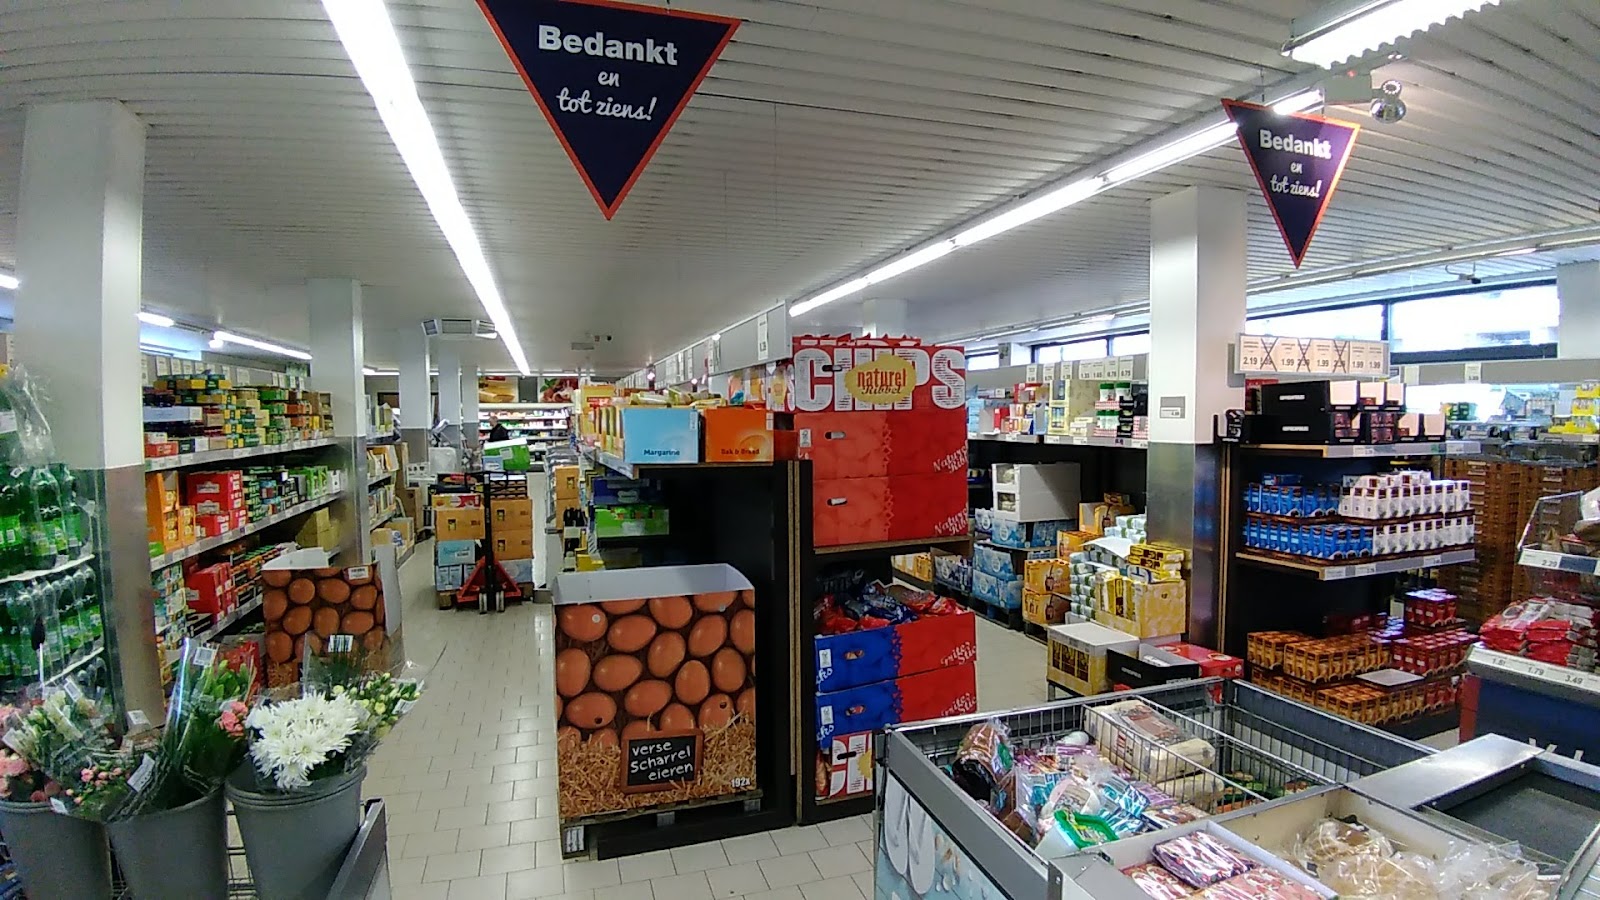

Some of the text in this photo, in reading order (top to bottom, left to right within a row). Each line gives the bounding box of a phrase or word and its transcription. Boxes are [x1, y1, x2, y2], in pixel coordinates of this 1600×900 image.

[538, 24, 678, 66] Bedankt
[598, 70, 620, 87] en
[556, 87, 657, 121] tot ziens!
[1259, 129, 1331, 159] Bedankt
[1290, 161, 1303, 174] en
[1270, 175, 1322, 198] tot ziens!
[857, 367, 906, 388] naturel
[643, 449, 680, 457] Margarine
[631, 746, 690, 773] Scharrel
[632, 741, 672, 757] verse
[648, 762, 692, 780] eieren
